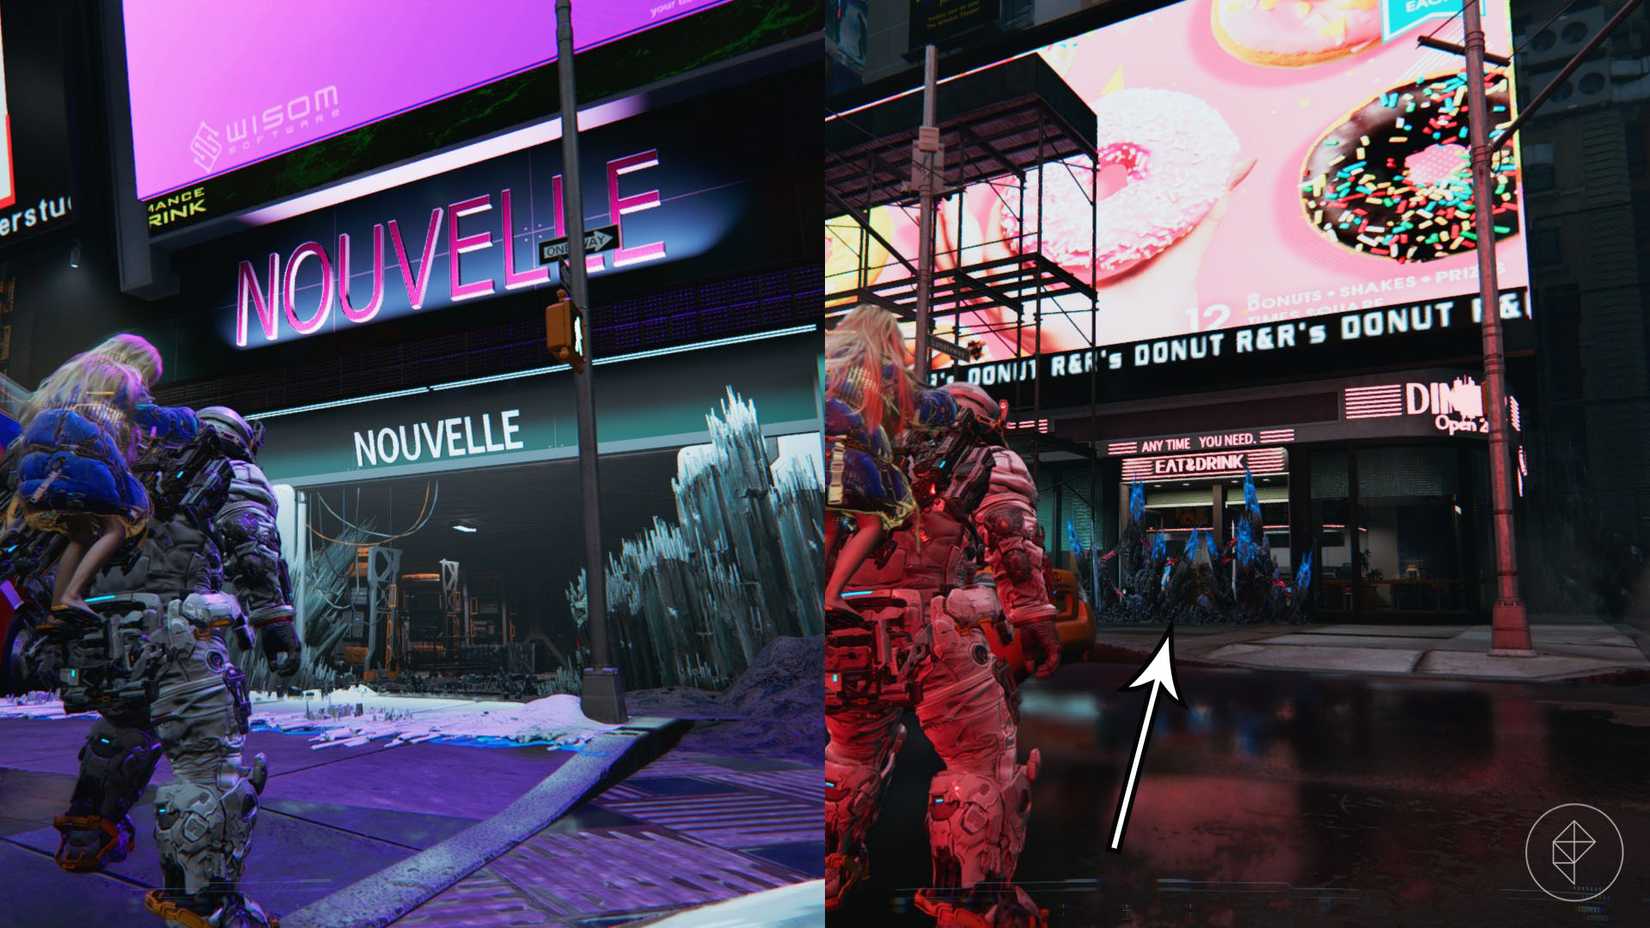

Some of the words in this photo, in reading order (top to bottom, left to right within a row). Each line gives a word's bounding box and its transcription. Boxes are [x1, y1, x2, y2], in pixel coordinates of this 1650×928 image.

[226, 85, 338, 143] WISOM
[236, 149, 666, 347] NOUVELLE
[1340, 275, 1417, 299] SHAKES
[1185, 303, 1232, 331] 12
[968, 359, 1037, 386] DONUT
[1051, 350, 1122, 377] R&R's
[1134, 333, 1225, 367] DONUT
[1236, 321, 1327, 355] R&R's
[1341, 302, 1454, 341] DONUT
[353, 409, 524, 467] NOUVELLE
[1434, 414, 1477, 436] Open
[1142, 440, 1163, 453] ANY
[1165, 437, 1191, 451] TIME
[1199, 435, 1223, 449] YOU
[1225, 432, 1258, 447] NEED.
[1155, 454, 1245, 475] EAT&DRINK
